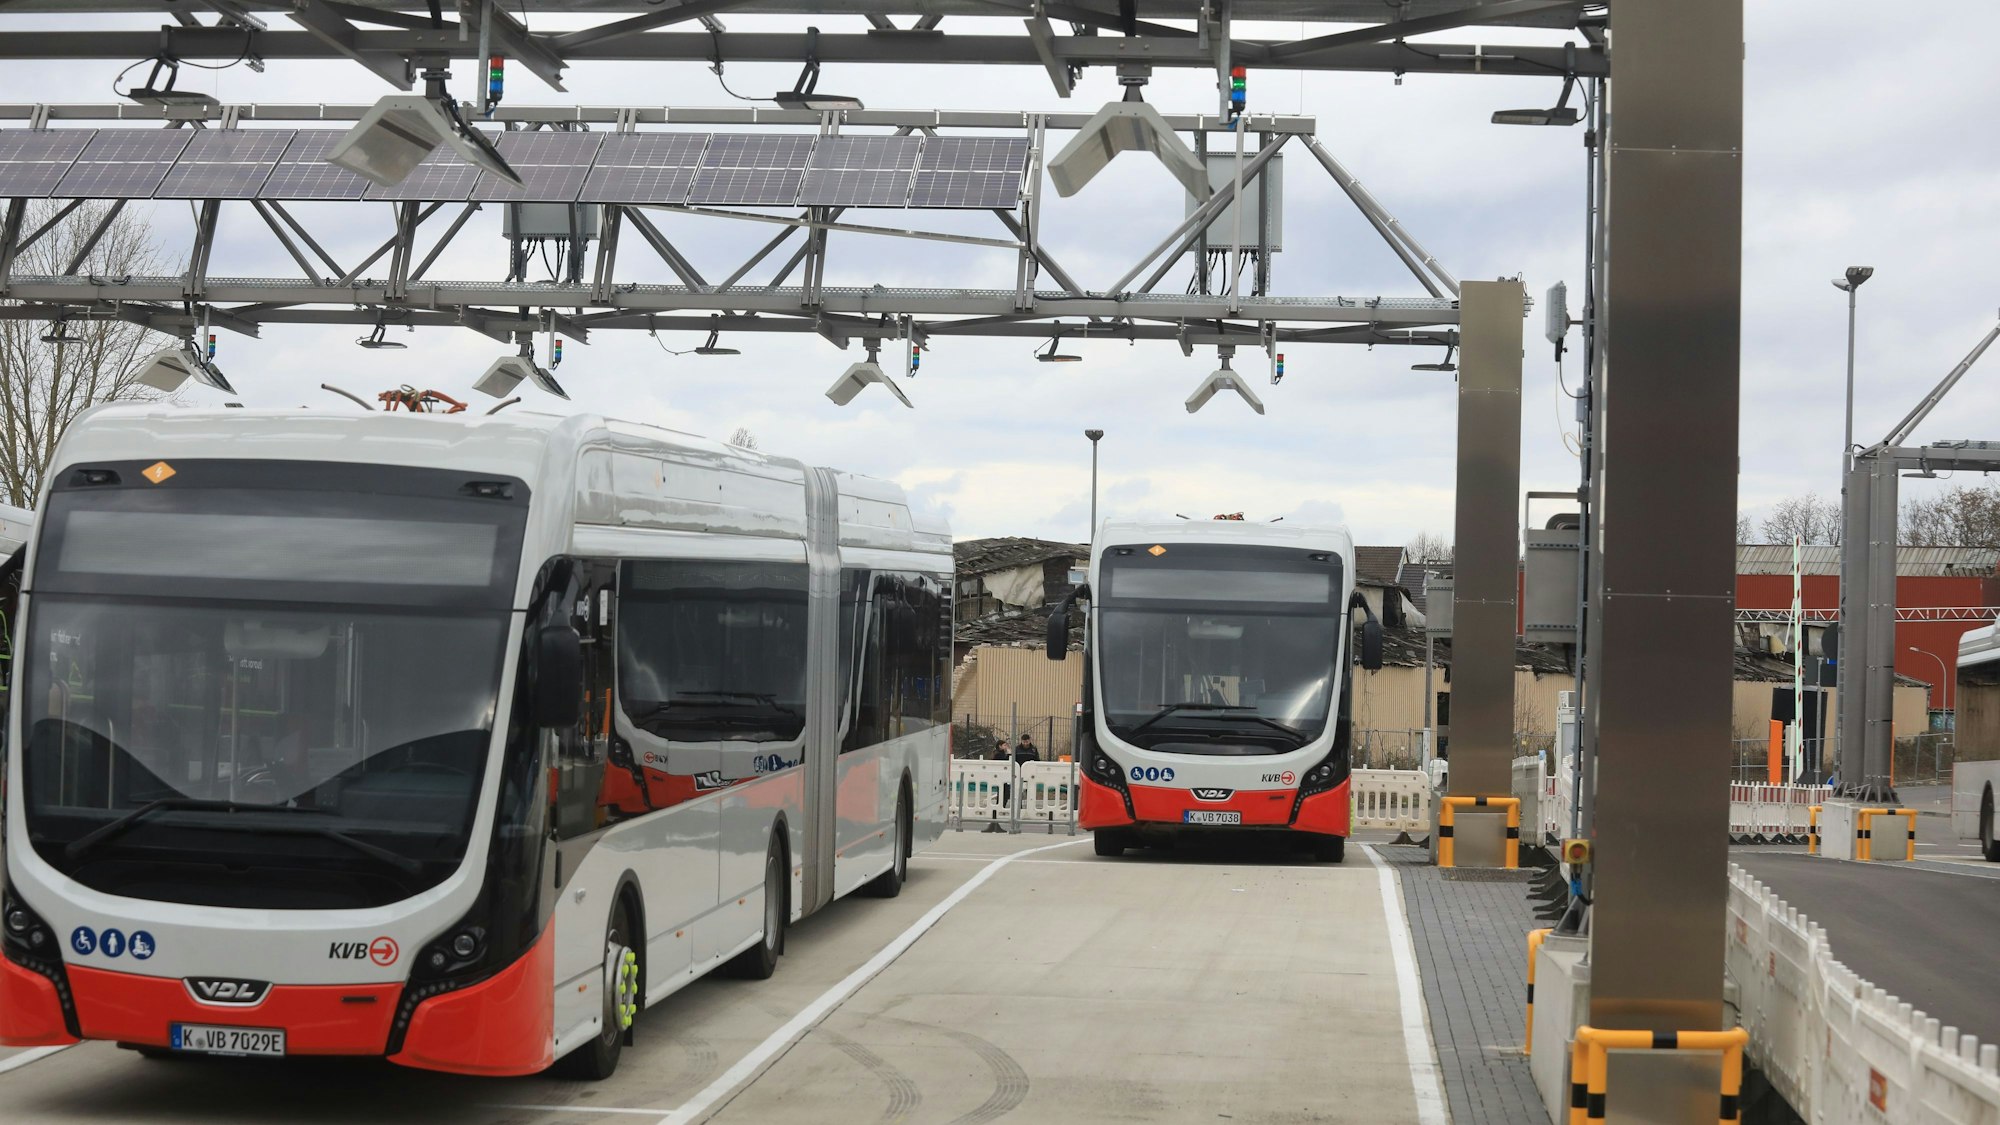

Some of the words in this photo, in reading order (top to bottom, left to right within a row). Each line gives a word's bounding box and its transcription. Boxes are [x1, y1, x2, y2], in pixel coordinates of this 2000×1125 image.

[1262, 773, 1280, 783] KVB
[1198, 790, 1227, 798] VDL
[1190, 812, 1196, 822] K
[1202, 813, 1214, 822] VB
[1216, 813, 1239, 823] 7038
[328, 942, 368, 959] KVB
[198, 981, 255, 998] VDL
[183, 1028, 193, 1047] K
[206, 1030, 227, 1049] VB
[230, 1032, 281, 1052] 7029E
